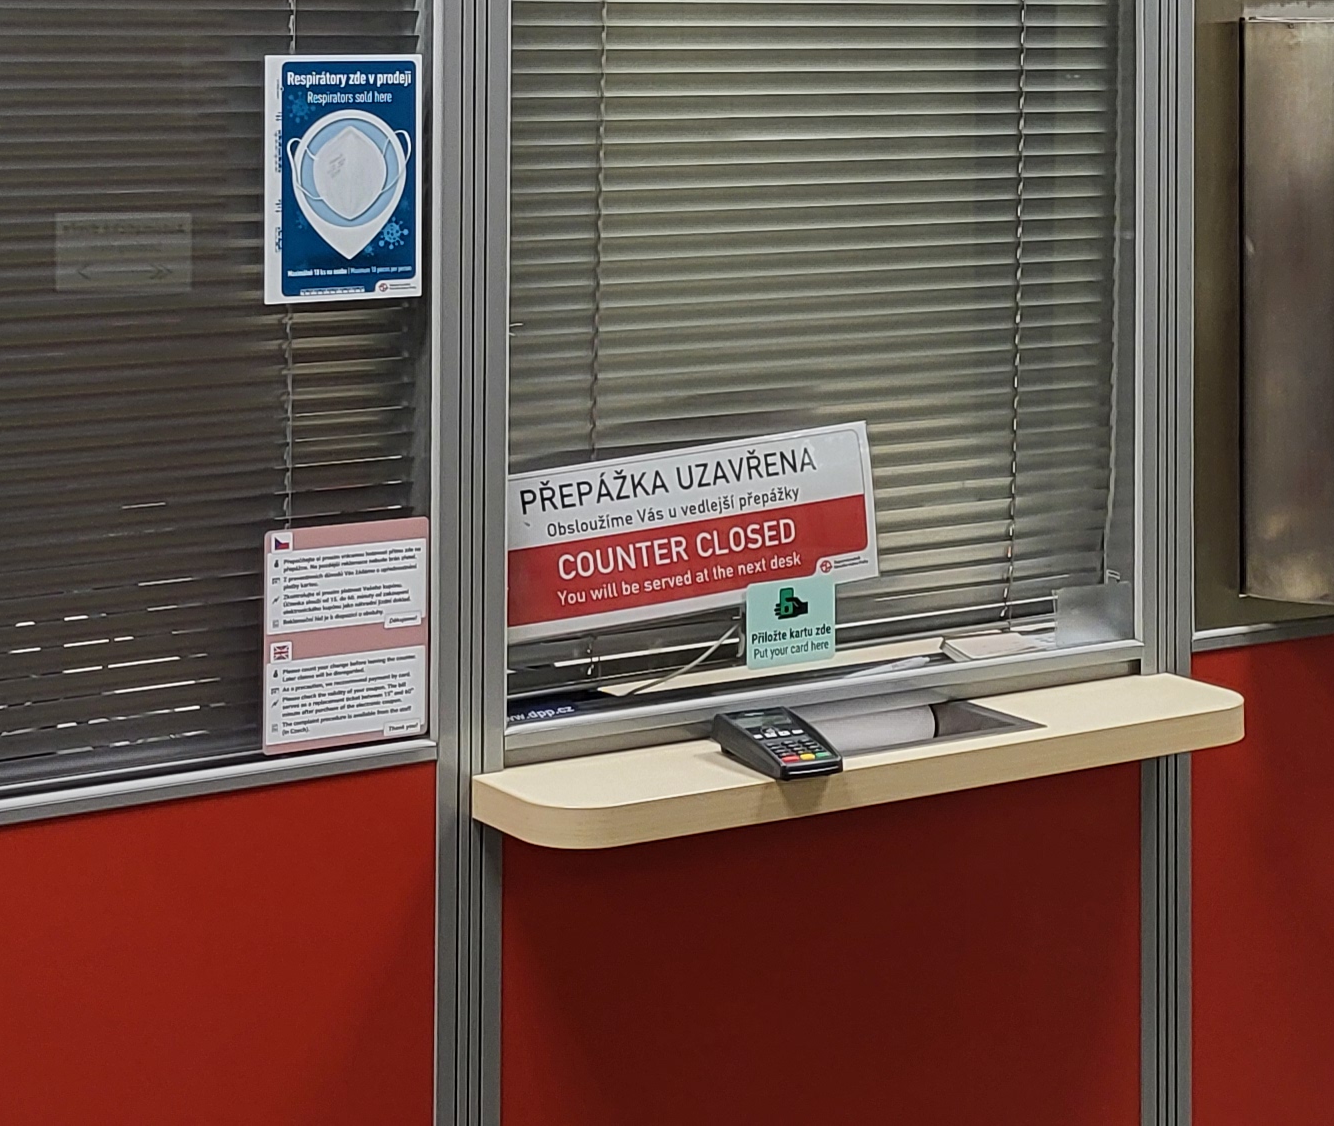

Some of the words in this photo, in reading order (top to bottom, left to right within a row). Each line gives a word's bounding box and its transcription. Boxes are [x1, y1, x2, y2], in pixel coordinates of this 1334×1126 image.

[287, 72, 346, 87] Respirátory
[349, 73, 366, 85] zde
[368, 75, 375, 83] v
[377, 71, 412, 87] prodeji
[307, 91, 353, 105] Respirators
[355, 92, 372, 102] sold
[374, 91, 392, 102] here
[520, 469, 669, 515] PŘEPÁŽKA
[677, 446, 817, 490] UZAVŘENA
[547, 514, 633, 538] Obsloužíme
[637, 507, 664, 523] Vás
[668, 508, 677, 518] u
[680, 495, 734, 517] vedlejší
[739, 486, 799, 511] přepážky
[557, 536, 688, 581] COUNTER
[696, 519, 796, 560] CLOSED
[557, 590, 586, 608] You
[590, 583, 618, 600] will
[622, 582, 639, 595] be
[644, 571, 692, 592] served
[696, 569, 709, 582] at
[713, 565, 733, 580] the
[737, 560, 766, 575] next
[770, 552, 801, 570] desk
[751, 629, 787, 645] Přiložte
[789, 627, 812, 641] kartu
[815, 624, 831, 637] zde
[753, 646, 769, 659] Put
[770, 645, 789, 659] your
[791, 642, 809, 655] card
[810, 639, 829, 652] here
